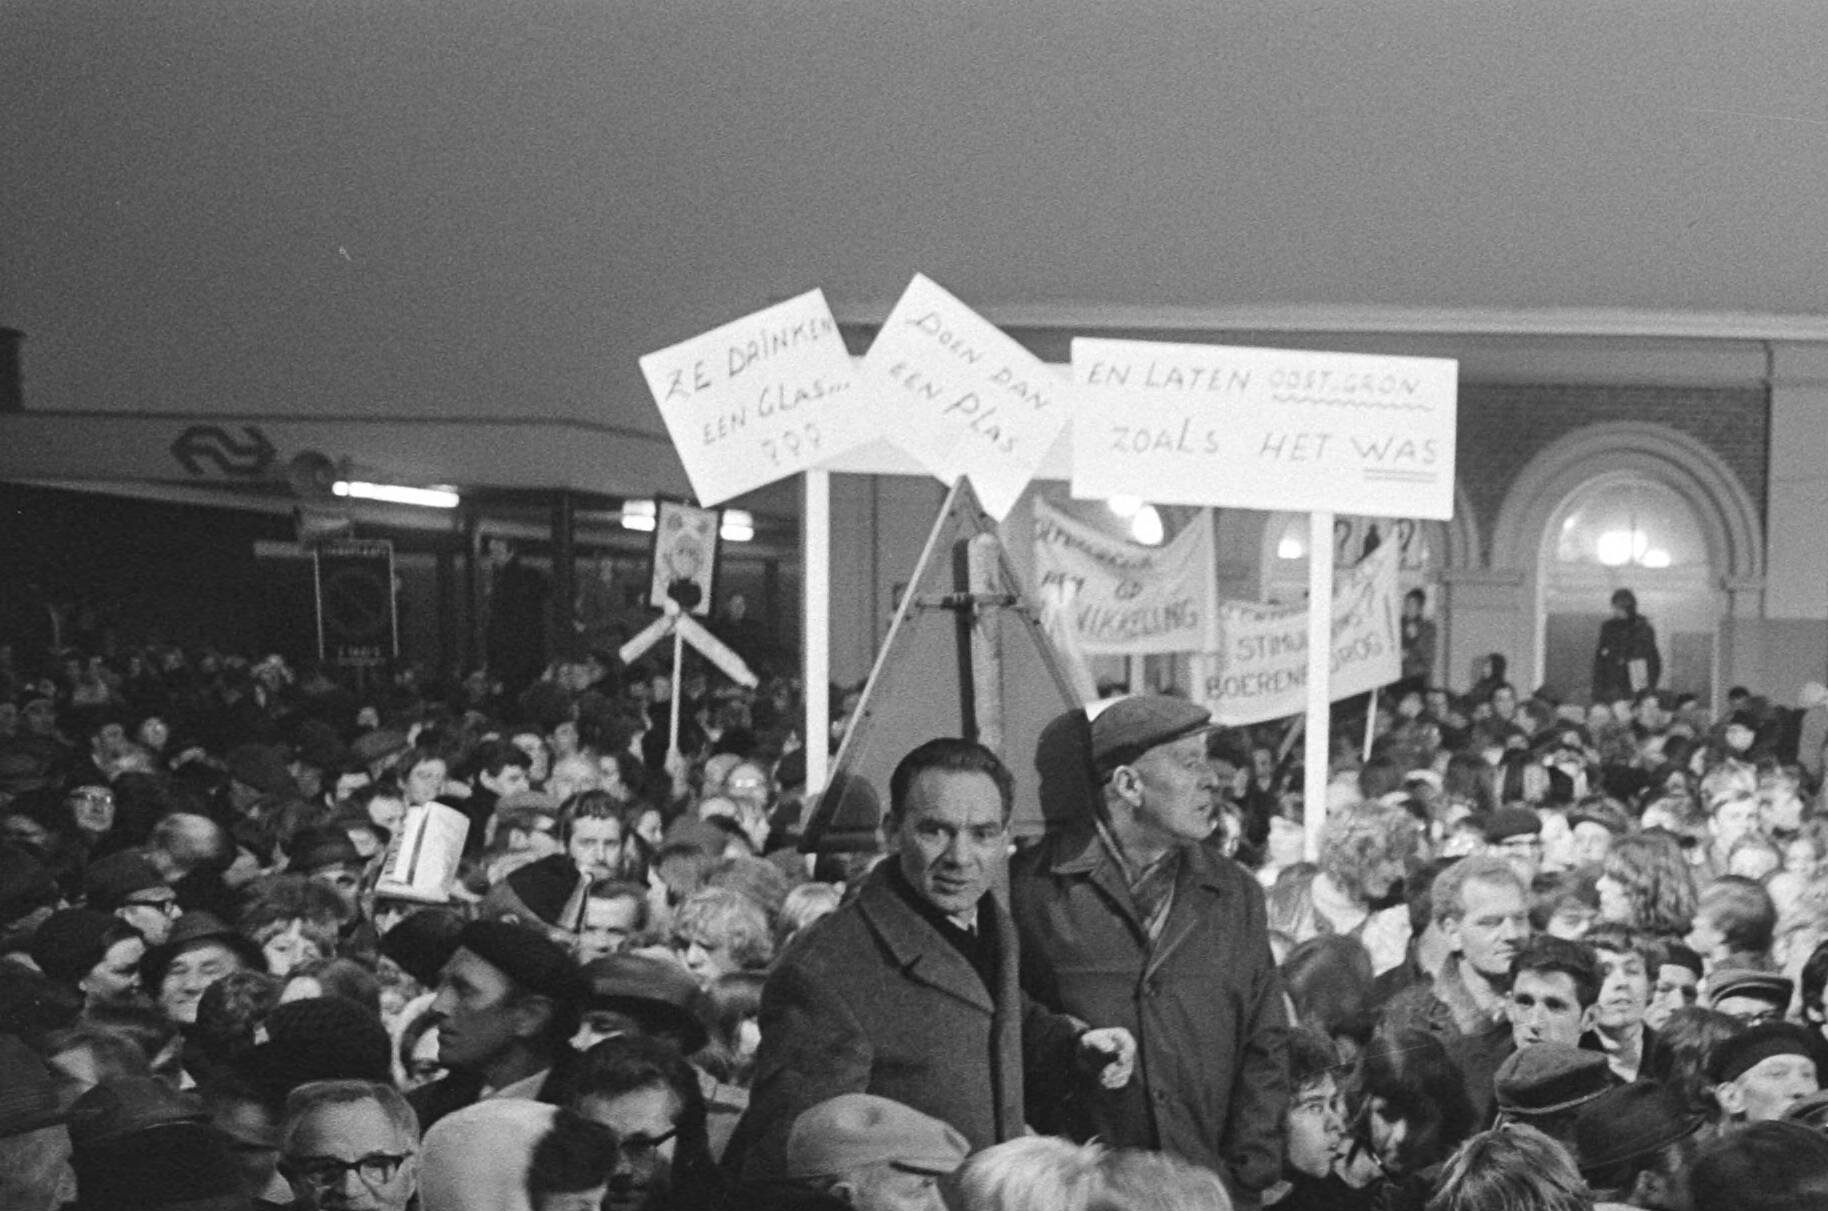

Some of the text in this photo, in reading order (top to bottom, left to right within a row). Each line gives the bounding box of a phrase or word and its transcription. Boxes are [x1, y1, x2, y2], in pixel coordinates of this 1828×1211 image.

[664, 358, 713, 400] ZE
[905, 310, 1051, 410] DOEN DAN
[1087, 359, 1132, 386] EN
[1144, 360, 1253, 393] LATEN
[703, 406, 746, 446] EEN
[889, 361, 1019, 454] EEN PLAS
[1109, 415, 1438, 466] ZOALS HET WAS
